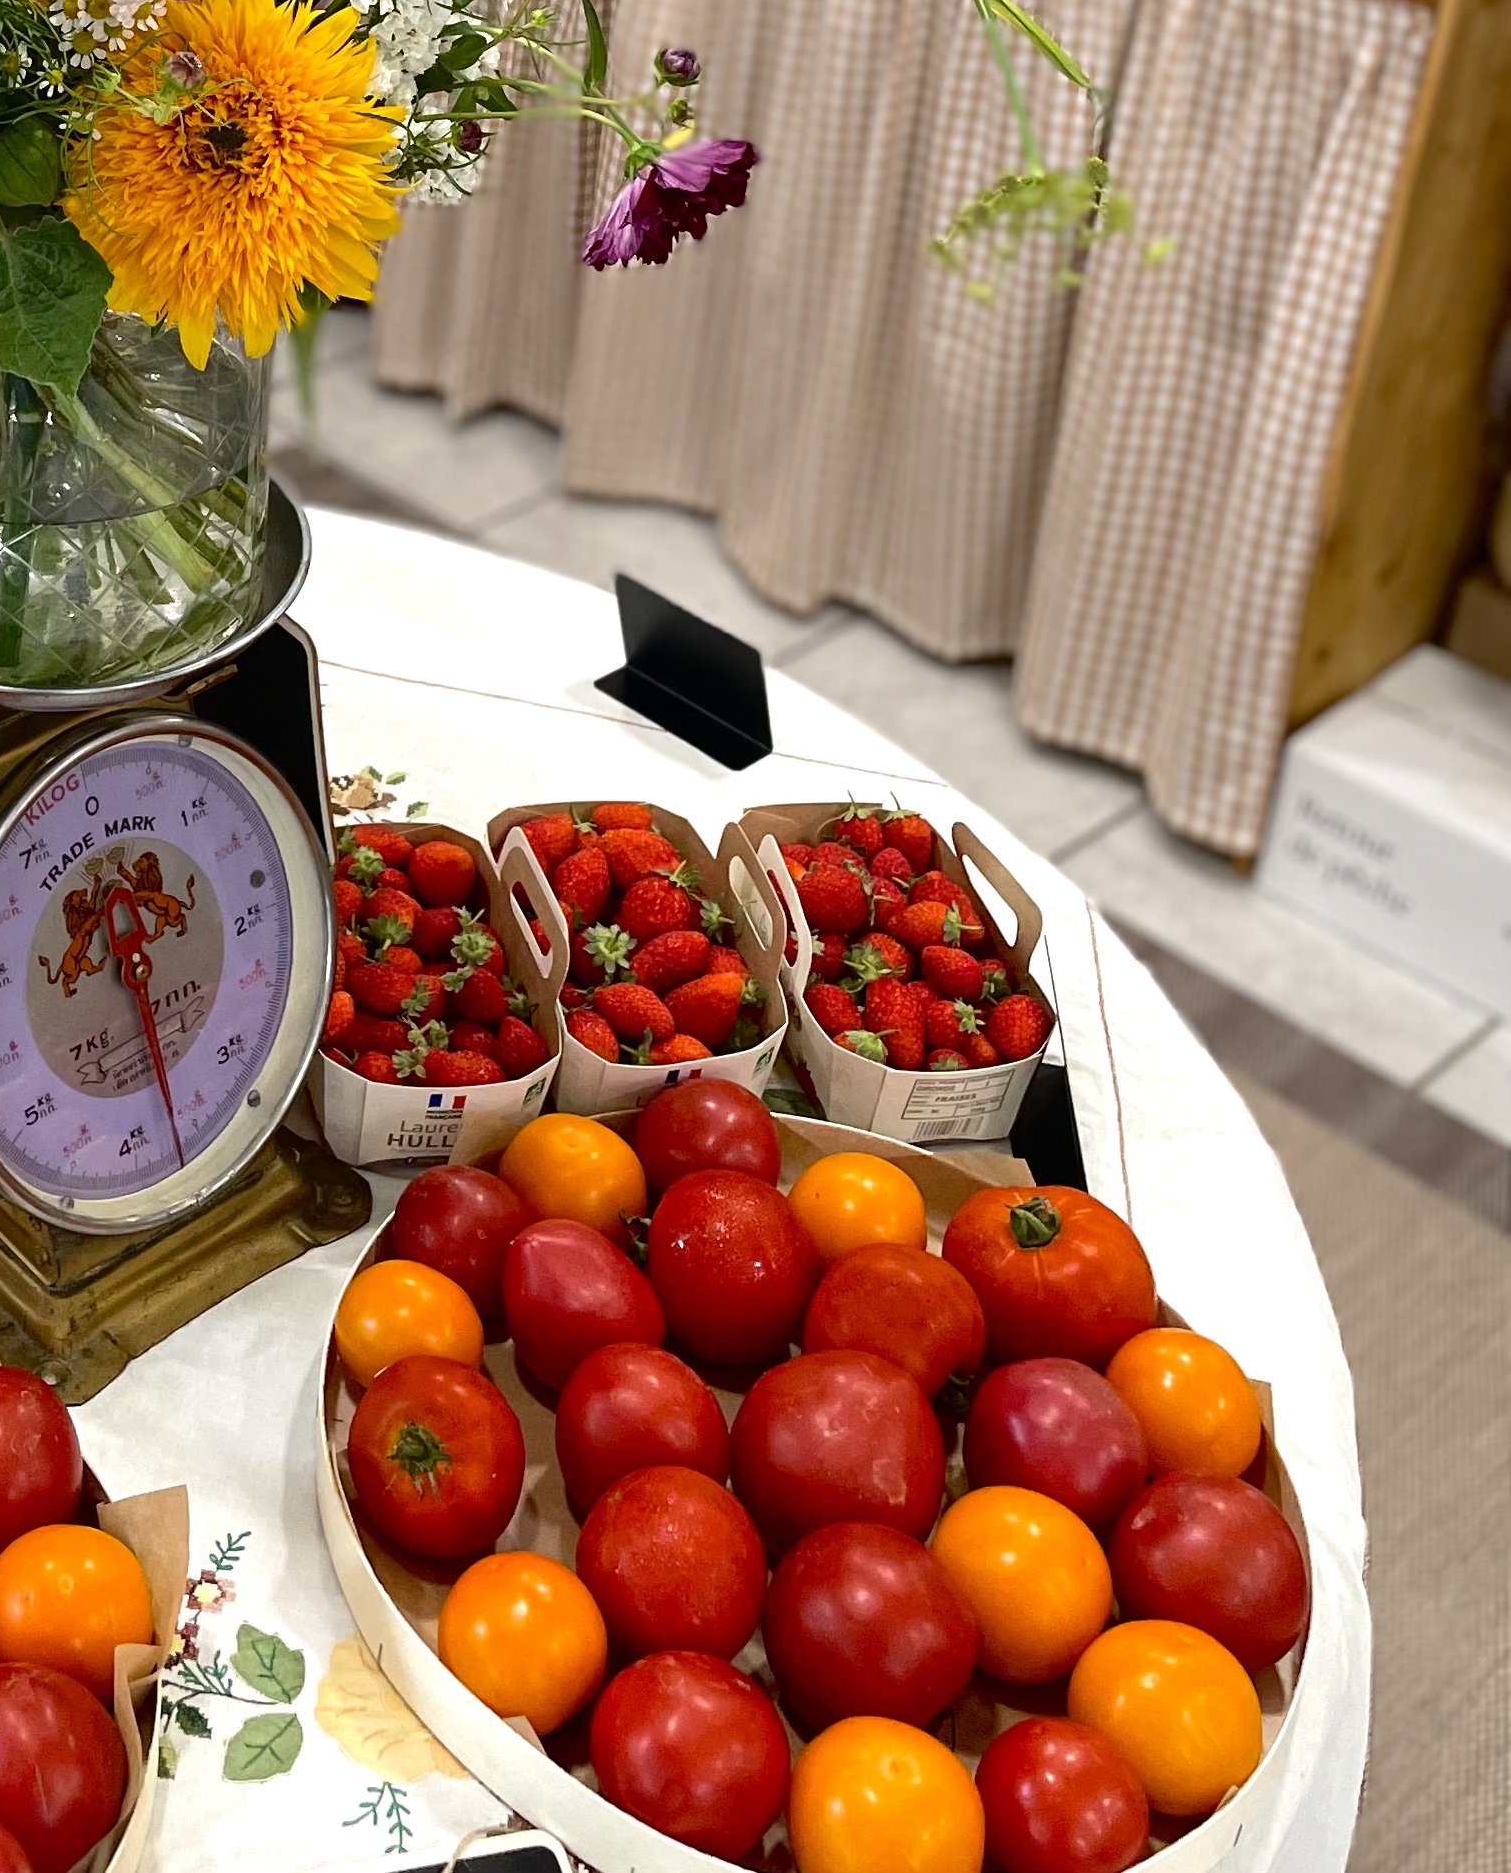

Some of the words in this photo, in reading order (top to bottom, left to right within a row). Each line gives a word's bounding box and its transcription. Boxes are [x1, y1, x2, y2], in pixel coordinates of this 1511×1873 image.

[24, 773, 81, 826] KILOG
[39, 831, 96, 892] TRADE
[104, 815, 156, 838] MARK
